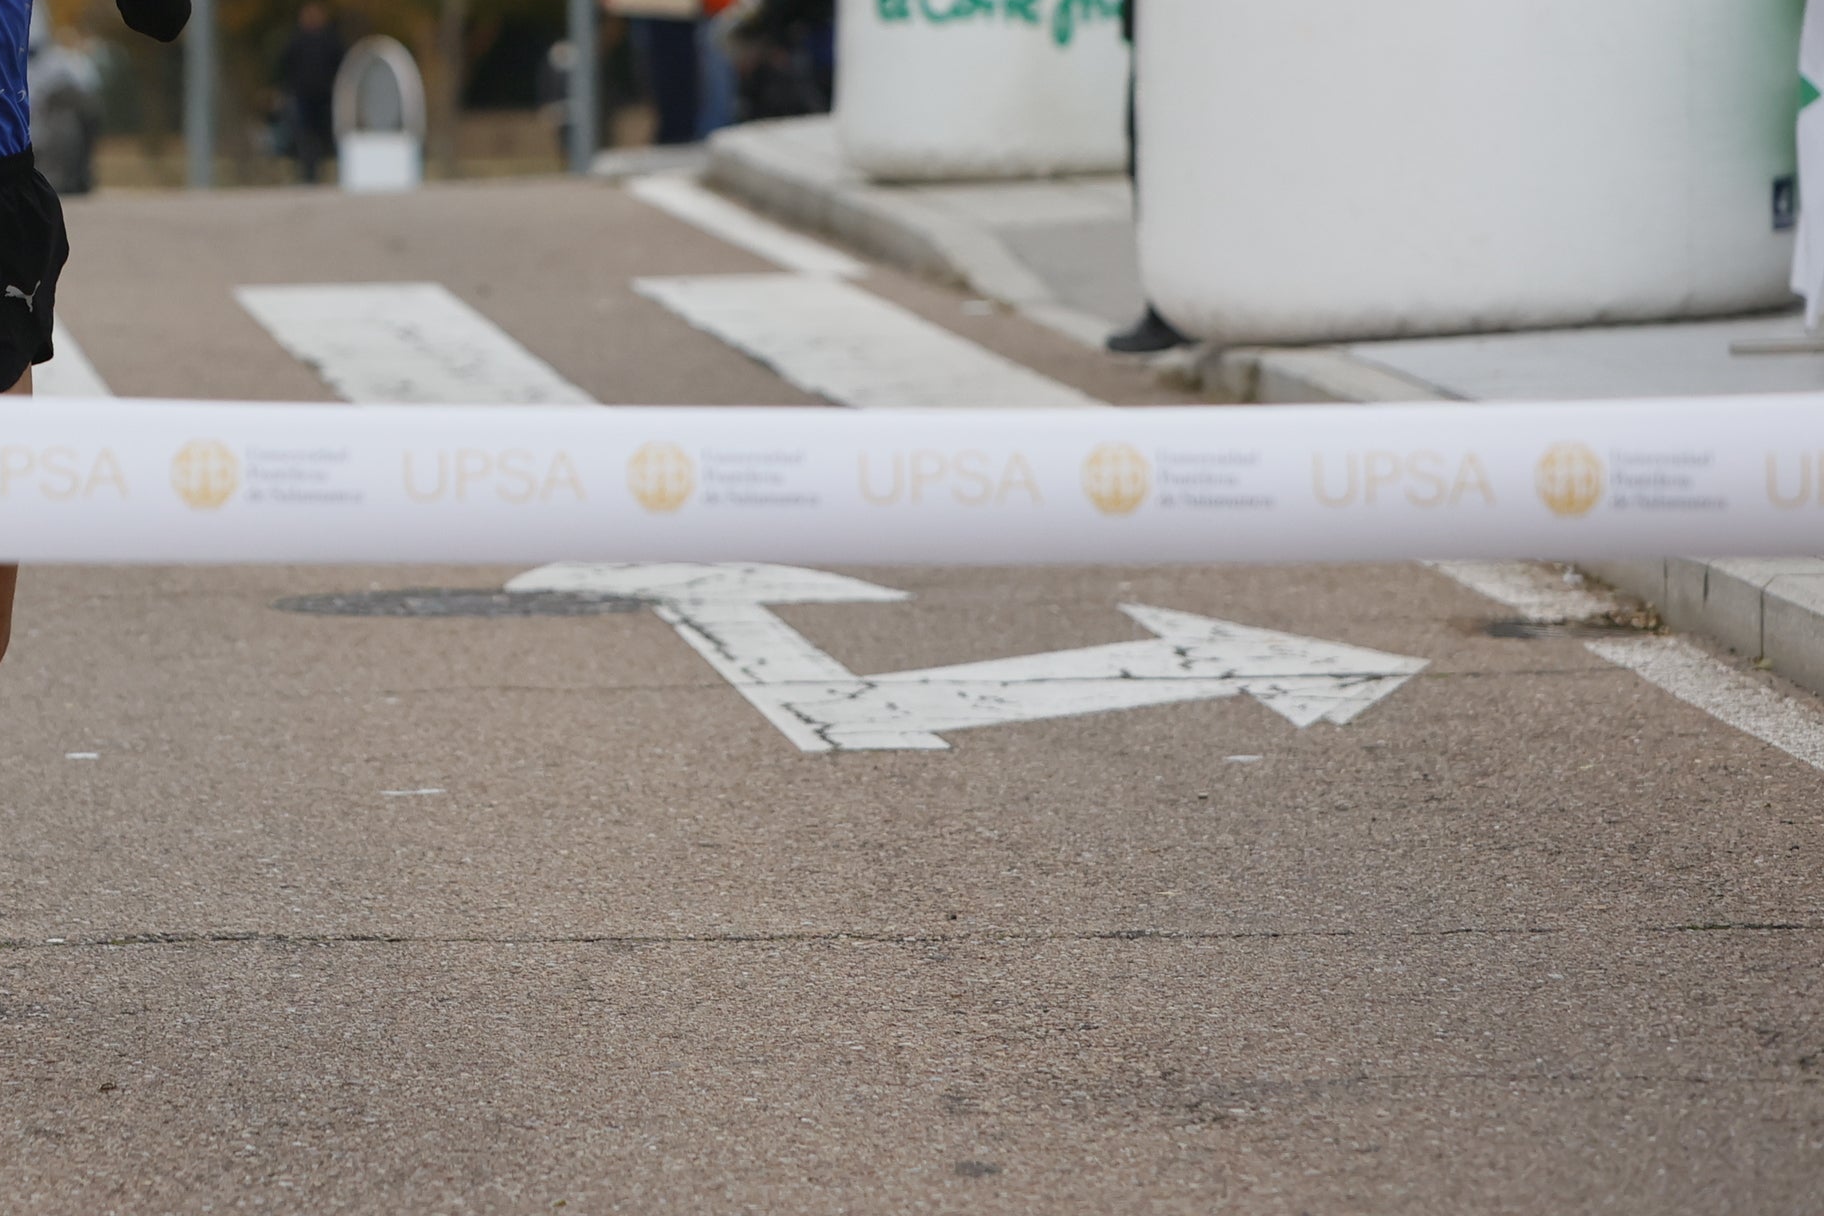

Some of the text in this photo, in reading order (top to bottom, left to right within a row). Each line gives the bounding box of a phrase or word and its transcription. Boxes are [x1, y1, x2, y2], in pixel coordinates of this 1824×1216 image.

[400, 447, 587, 505] UPSA
[856, 448, 1044, 508] UPSA
[1311, 448, 1498, 509] UPSA
